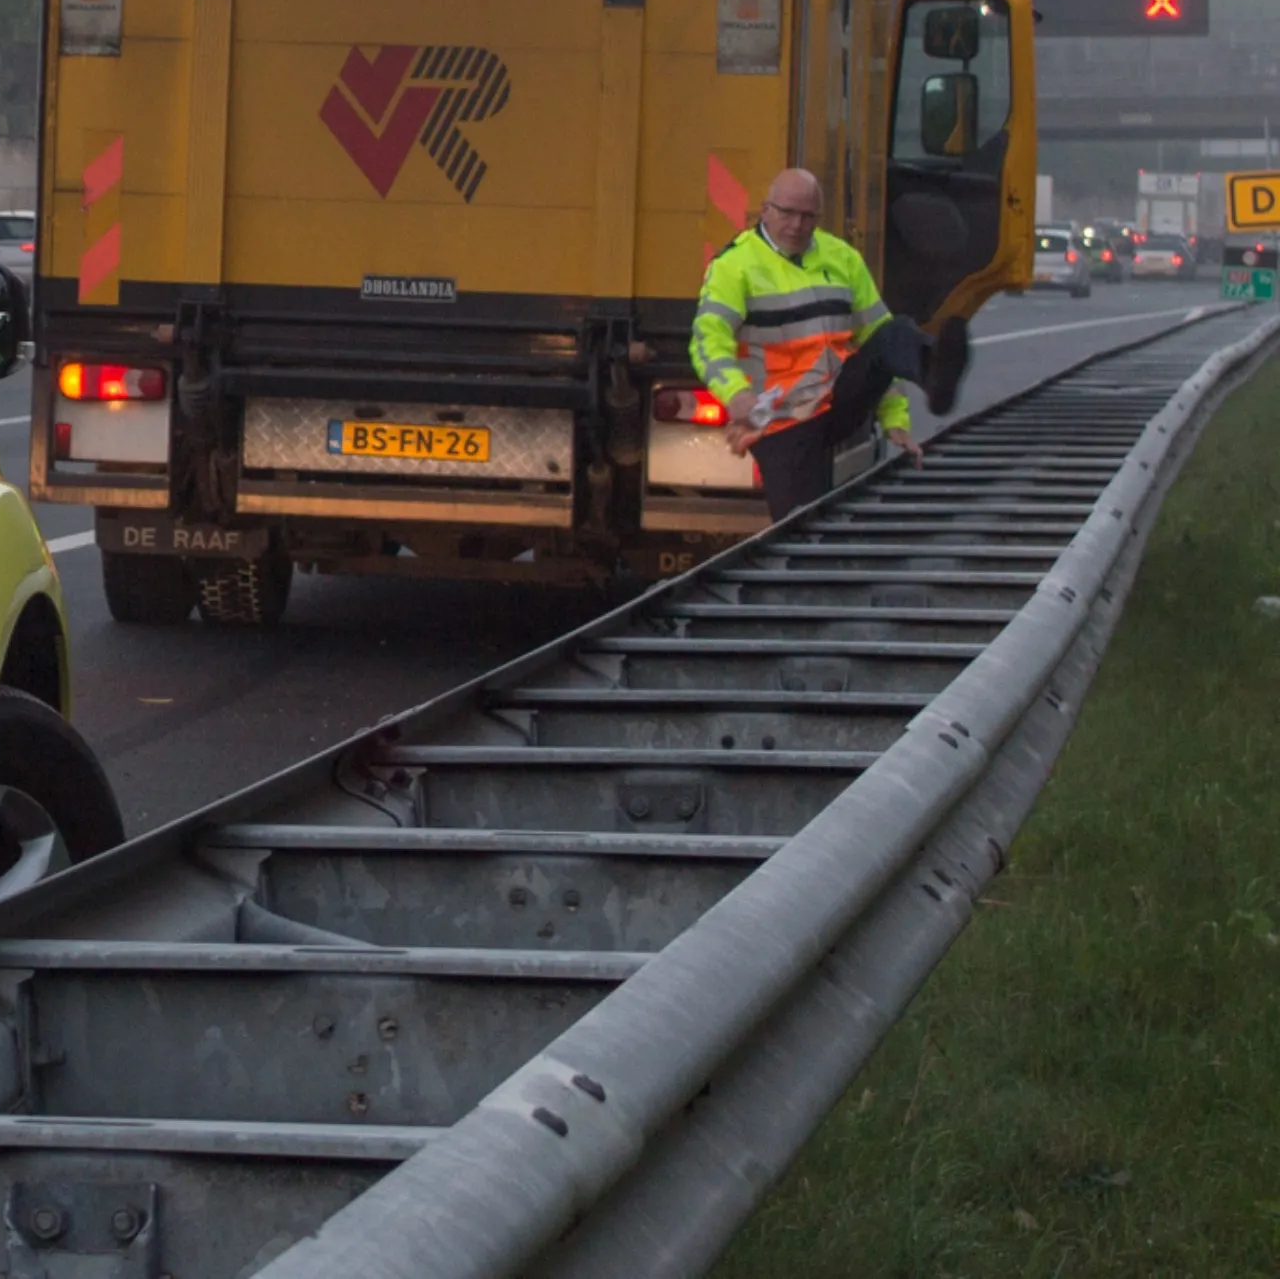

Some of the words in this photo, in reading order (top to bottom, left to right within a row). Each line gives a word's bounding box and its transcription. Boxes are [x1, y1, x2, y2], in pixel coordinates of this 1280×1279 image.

[1252, 186, 1275, 214] D
[363, 279, 454, 297] DHOLLANDIA
[352, 426, 481, 457] BS-FN-26
[123, 526, 157, 547] DE
[173, 529, 239, 552] RAAF
